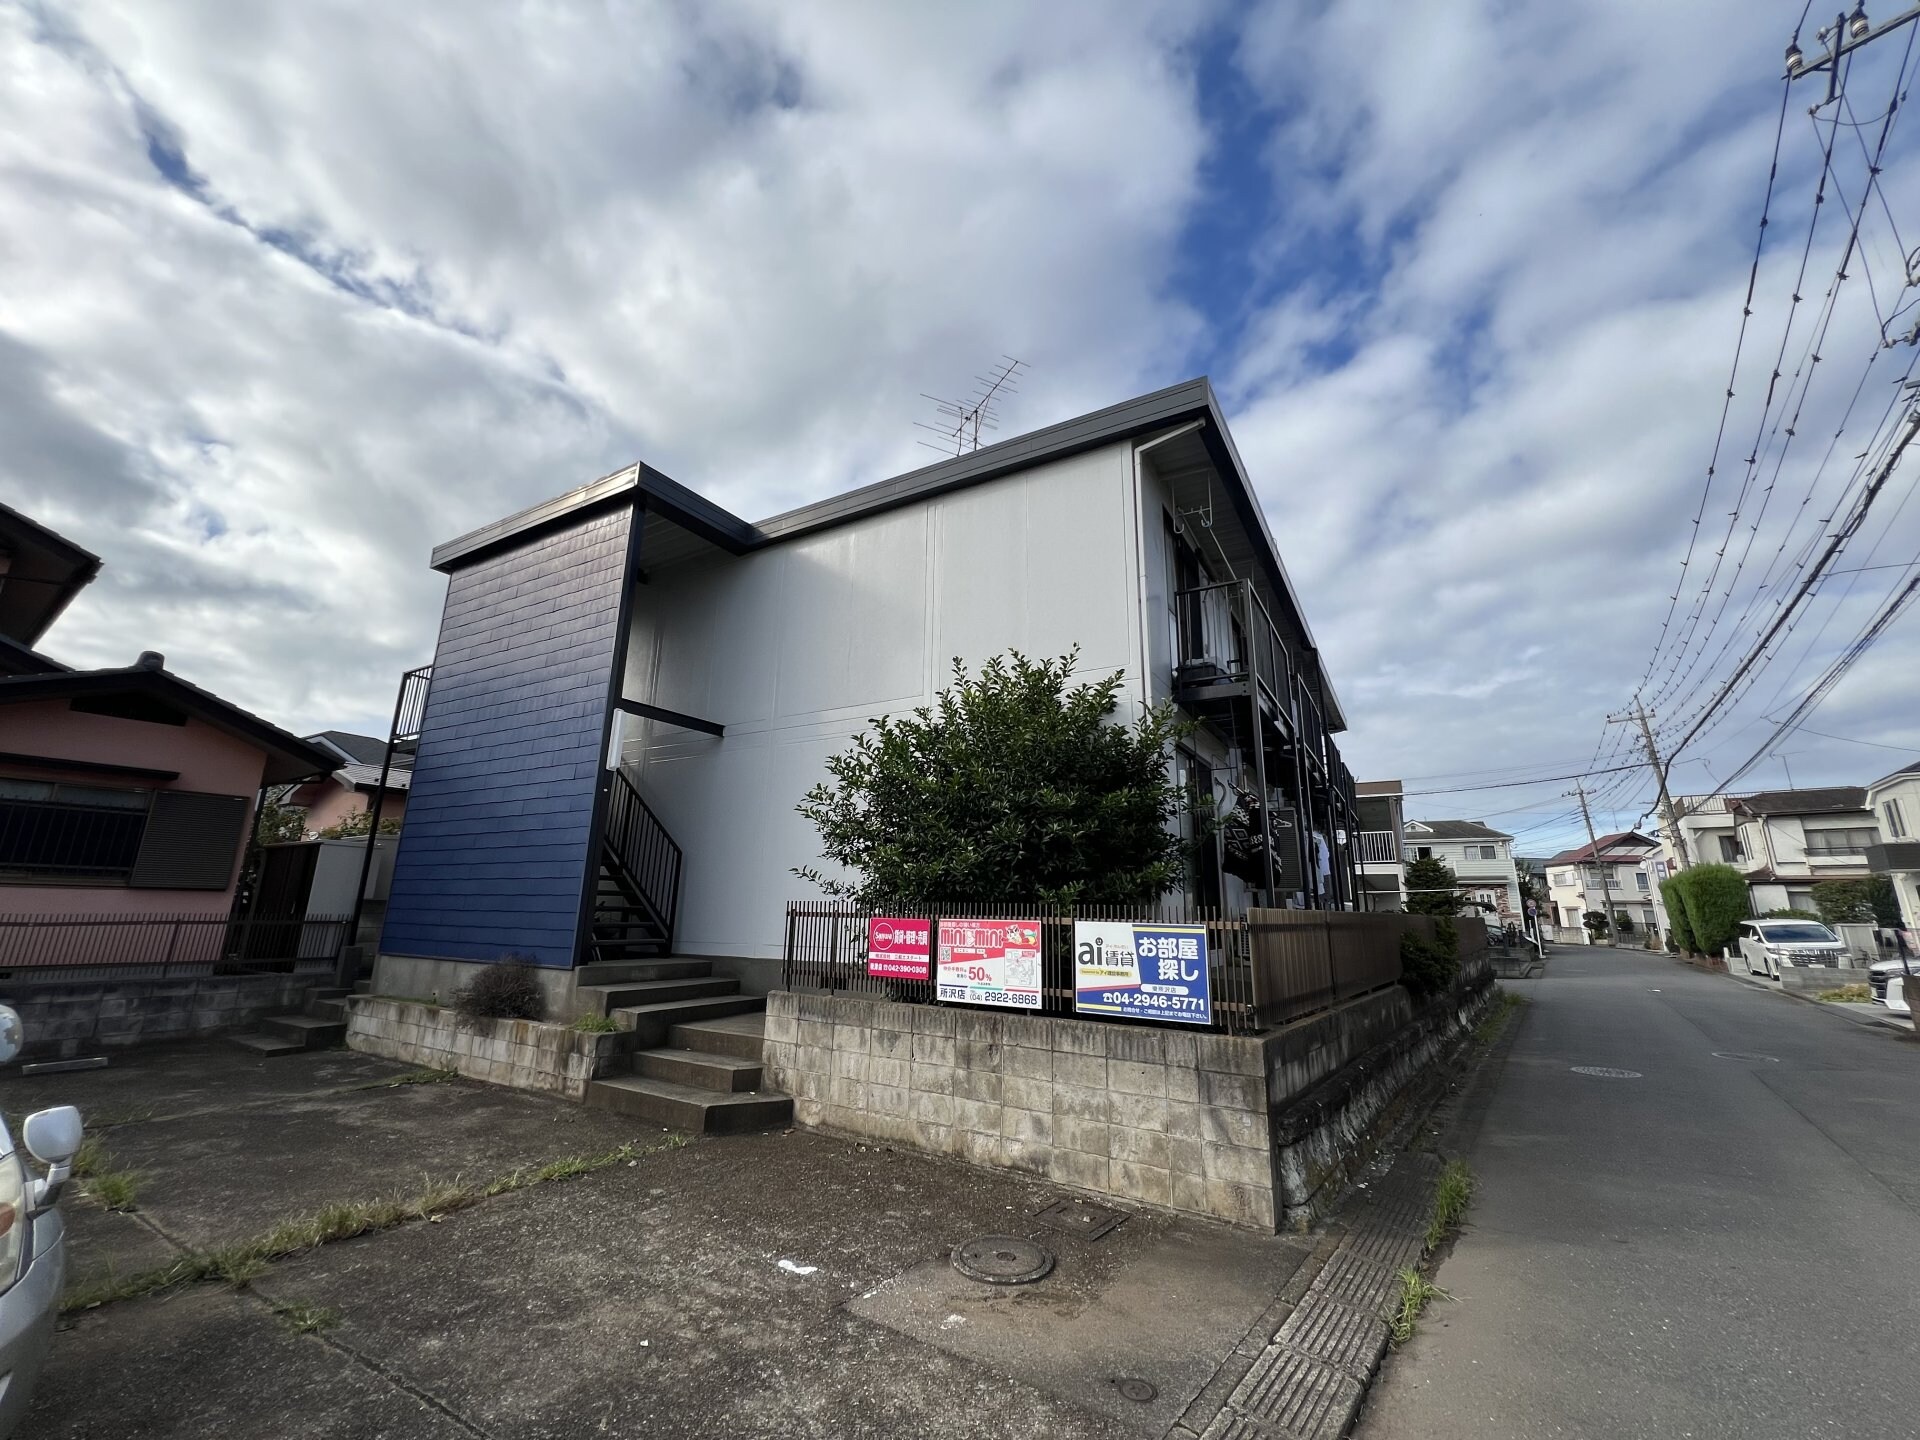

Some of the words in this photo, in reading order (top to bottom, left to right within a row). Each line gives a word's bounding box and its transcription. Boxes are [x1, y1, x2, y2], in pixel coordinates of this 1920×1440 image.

[940, 928, 967, 946] mini
[974, 929, 1003, 948] mini
[1138, 937, 1199, 960] お部屋
[1105, 950, 1134, 967] 賃貸
[968, 966, 992, 982] 50%
[1158, 959, 1199, 981] 探し
[940, 988, 966, 1000] 所沢店
[984, 991, 1038, 1005] 2922-6868
[1113, 991, 1205, 1012] 04-2946-5771
